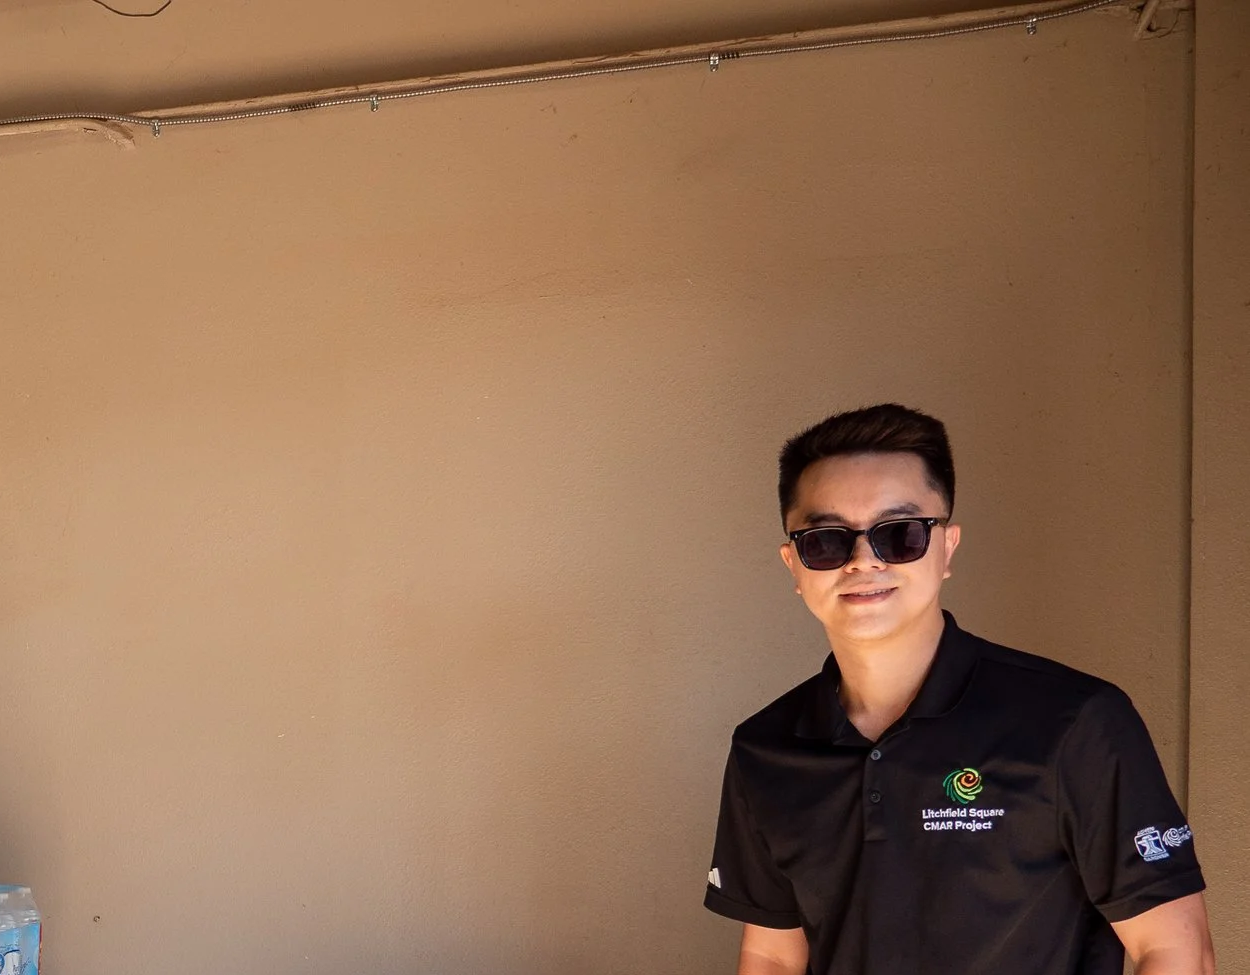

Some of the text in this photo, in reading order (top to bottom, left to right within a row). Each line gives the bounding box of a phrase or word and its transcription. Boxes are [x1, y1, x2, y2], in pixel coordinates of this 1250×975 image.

[922, 807, 1005, 819] Litchfield Square
[923, 820, 993, 832] CMAR Project
